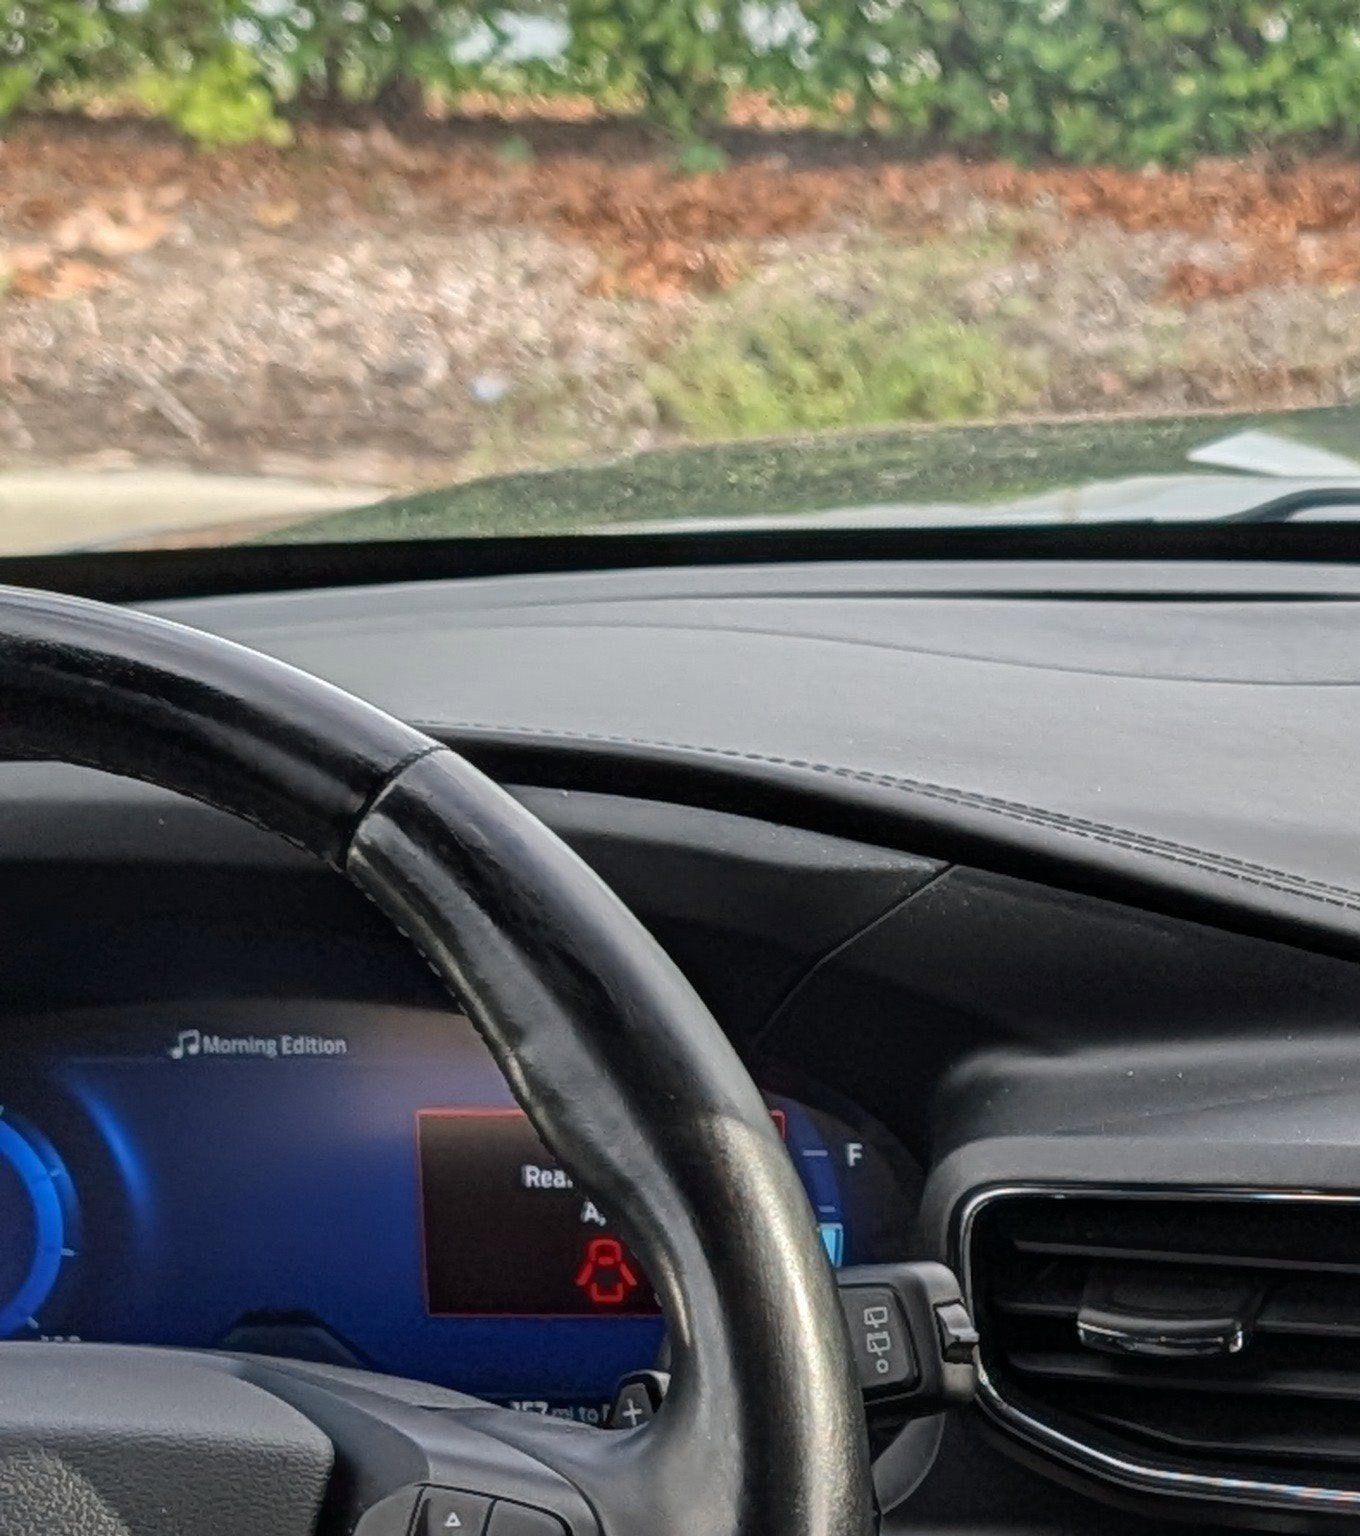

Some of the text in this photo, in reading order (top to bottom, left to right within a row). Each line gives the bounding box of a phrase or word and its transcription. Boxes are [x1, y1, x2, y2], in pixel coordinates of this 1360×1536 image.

[203, 1035, 348, 1058] Morning Edition
[845, 1143, 864, 1167] F
[522, 1164, 574, 1189] Rea
